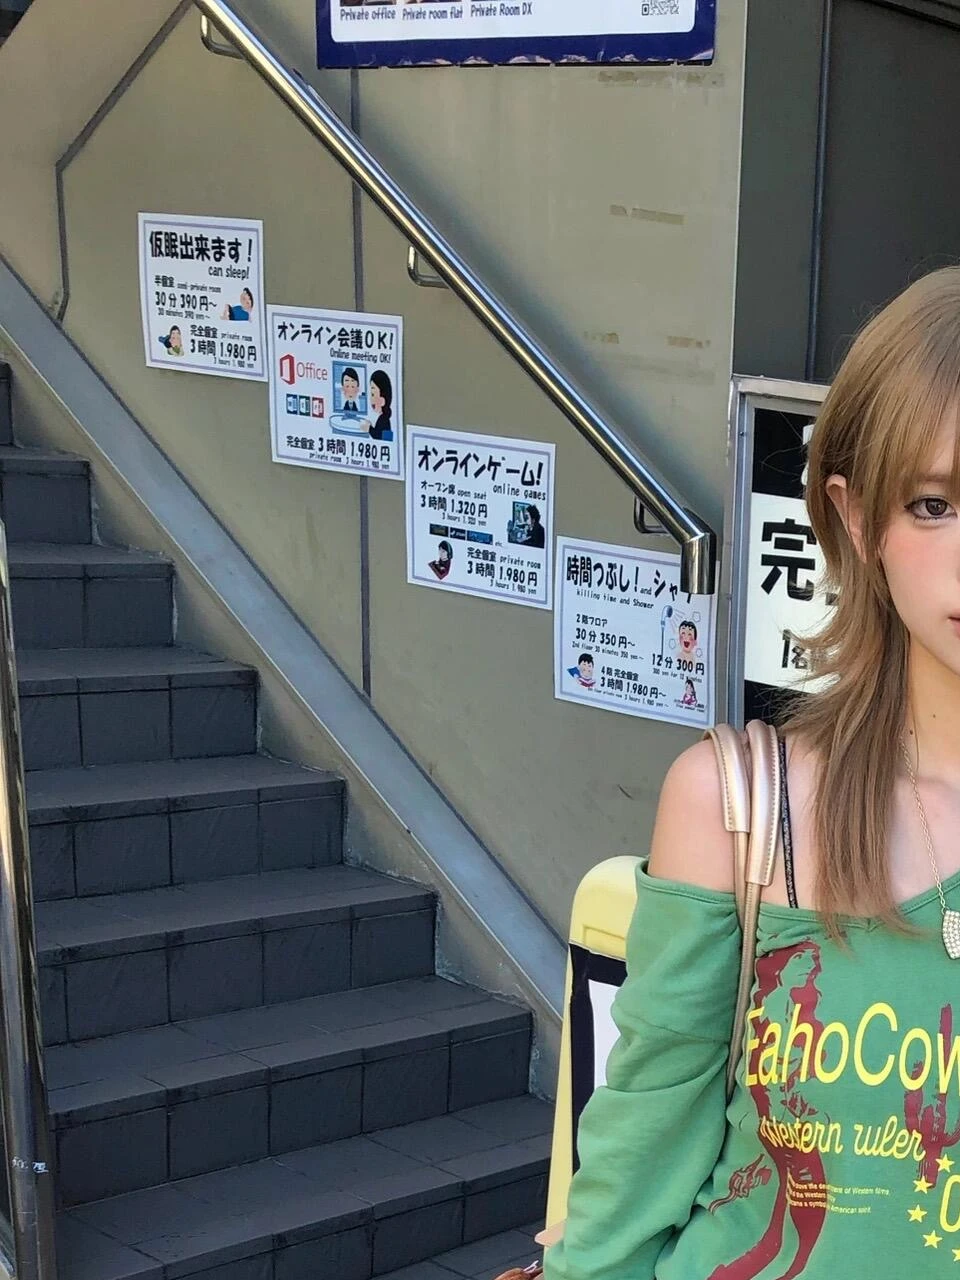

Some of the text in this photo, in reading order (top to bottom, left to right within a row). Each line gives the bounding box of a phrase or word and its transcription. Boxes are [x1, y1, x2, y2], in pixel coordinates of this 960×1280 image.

[340, 7, 396, 20] Private office
[403, 7, 426, 20] Private
[428, 8, 448, 18] room
[471, 3, 532, 16] Private Room DX
[208, 266, 250, 281] can sleep!
[330, 348, 391, 363] Online meeting OK!
[297, 362, 328, 380] Office
[493, 484, 546, 501] online games
[633, 599, 654, 609] Shower
[760, 1115, 926, 1161] Western ruler
